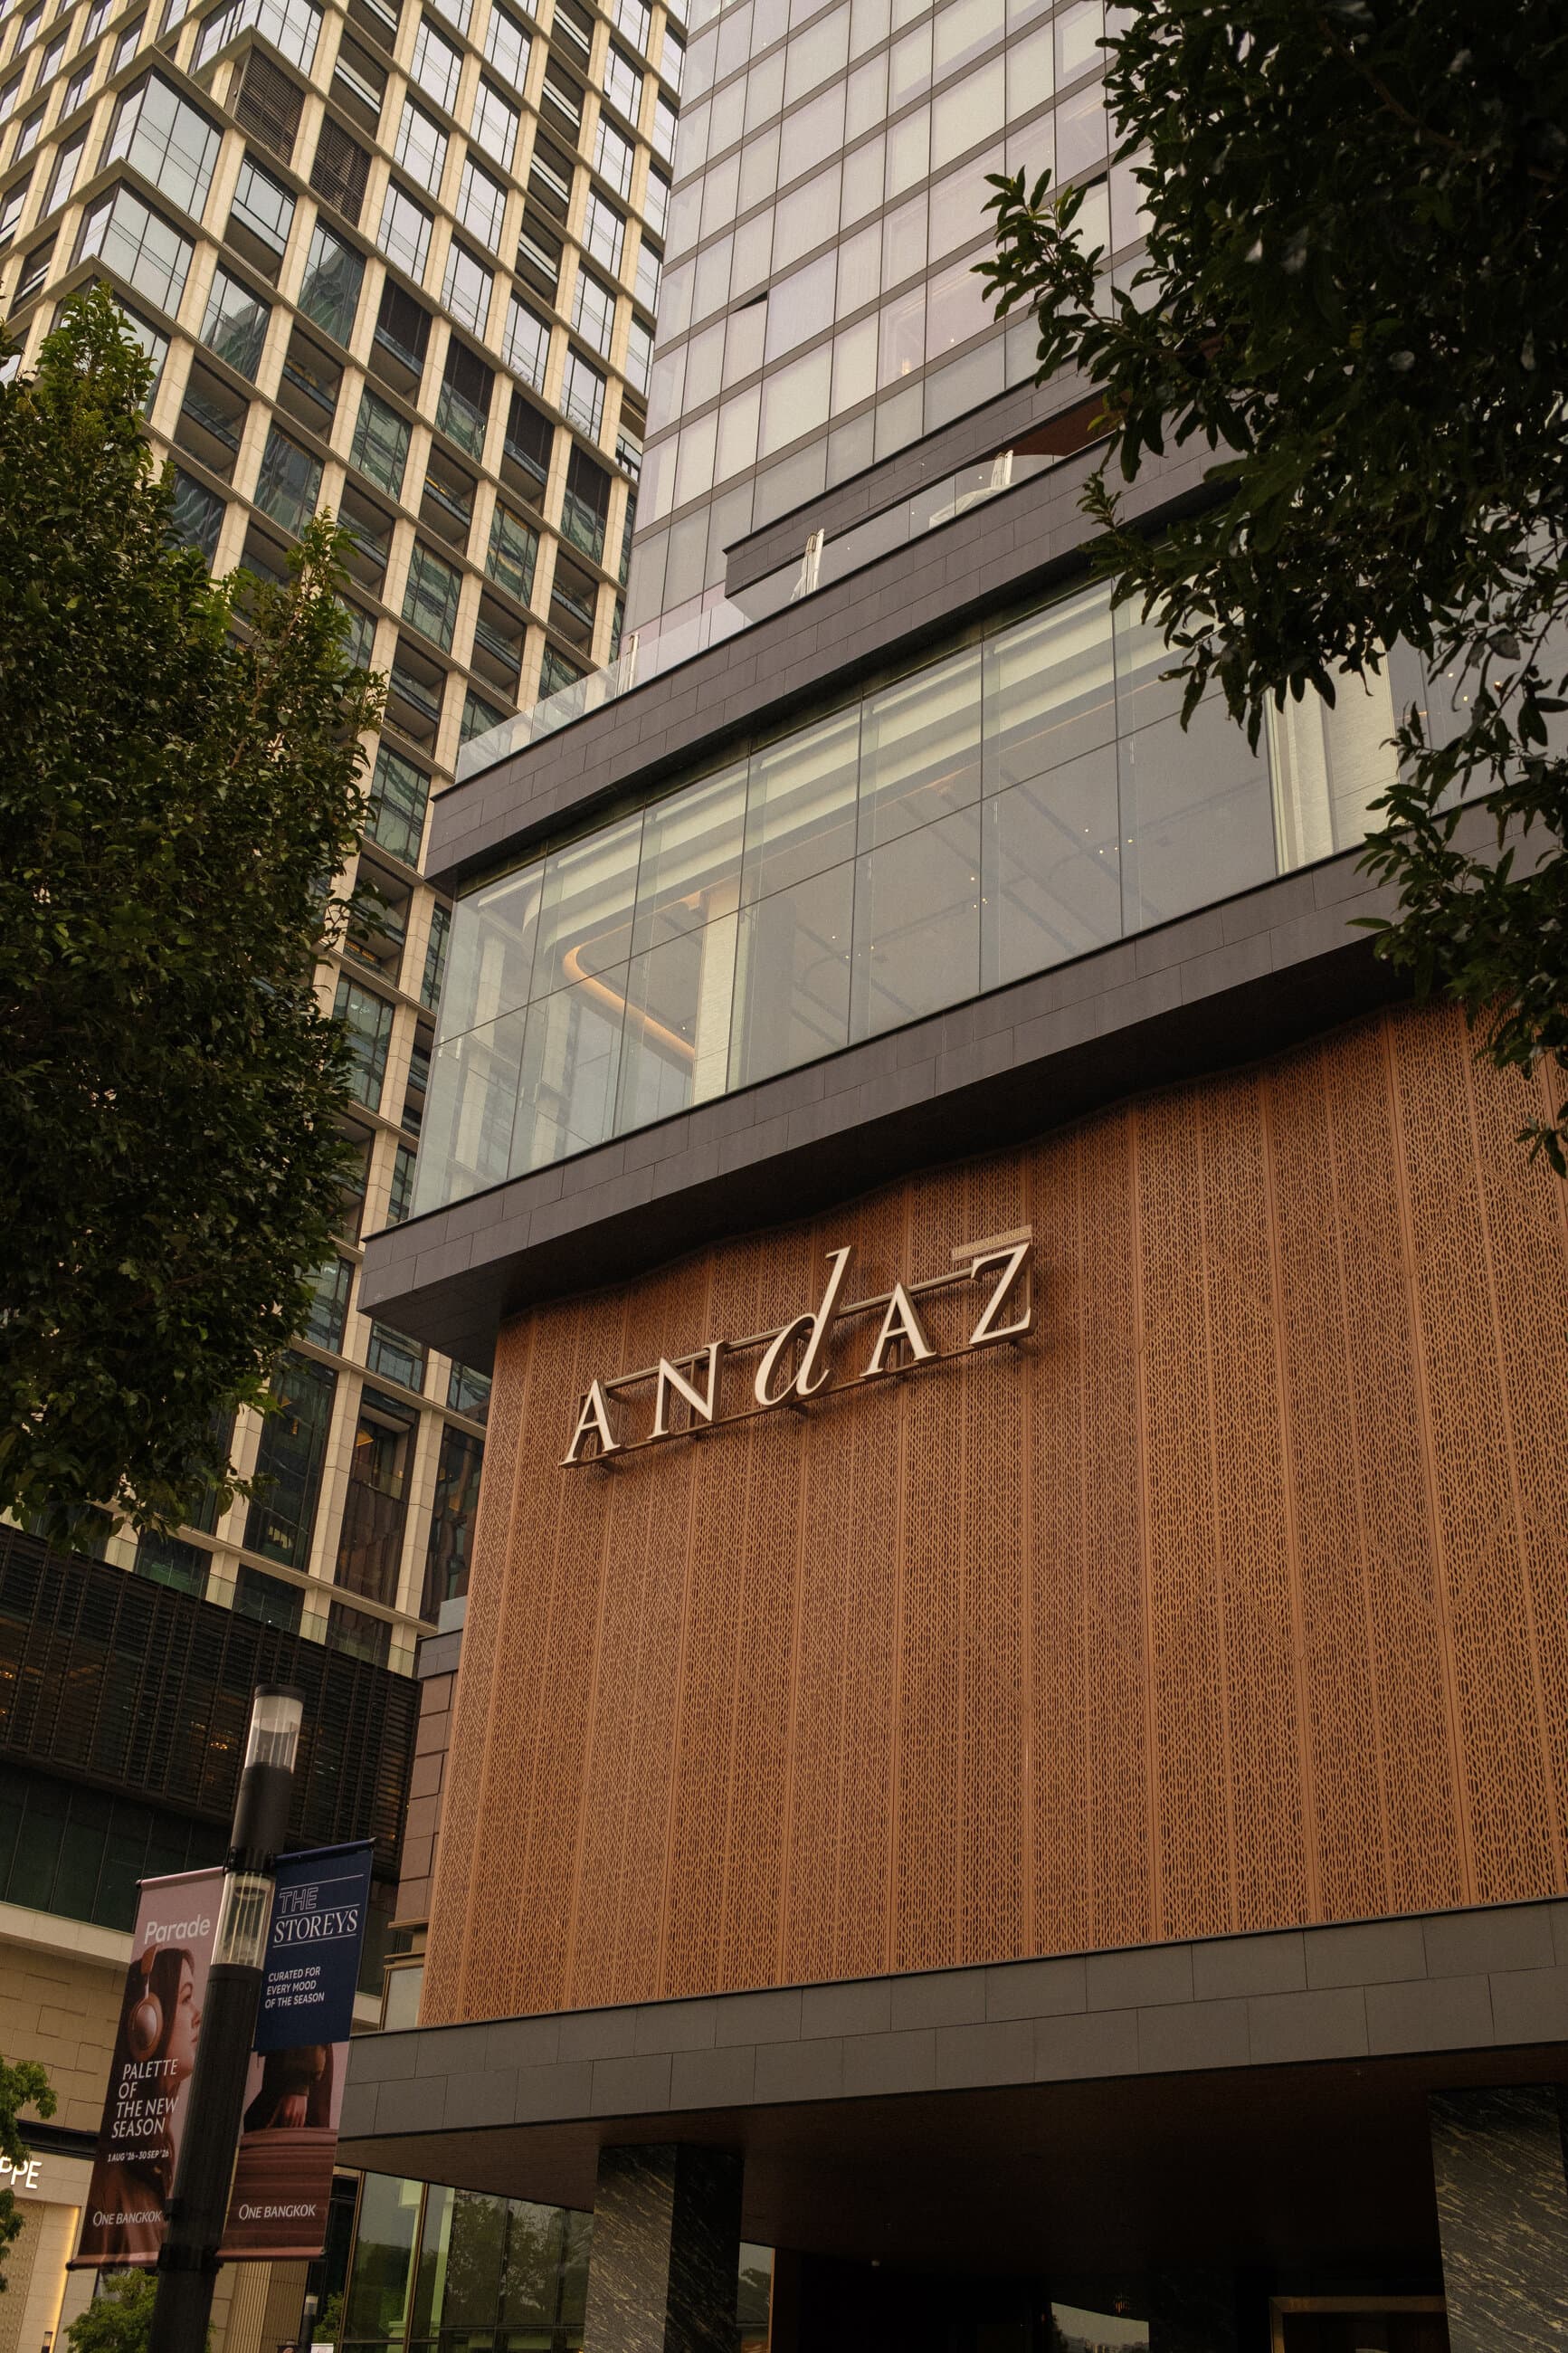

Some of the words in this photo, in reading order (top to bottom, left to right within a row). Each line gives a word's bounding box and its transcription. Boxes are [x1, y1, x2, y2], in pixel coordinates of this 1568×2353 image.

[280, 1887, 318, 1914] THE
[145, 1914, 211, 1945] Parade
[273, 1909, 358, 1943] STOREYS
[268, 1967, 303, 1982] CURATED
[305, 1966, 321, 1977] FOR
[266, 1983, 291, 1996] EVERY
[292, 1980, 317, 1992] MOOD
[264, 1997, 276, 2009] OF
[277, 1996, 292, 2006] THE
[293, 1992, 325, 2005] SEASON
[122, 2059, 179, 2081] PALETTE
[119, 2082, 138, 2100] OF
[117, 2100, 143, 2119] THE
[145, 2096, 179, 2116] NEW
[111, 2117, 166, 2139] SEASON
[92, 2211, 115, 2226] ONE
[116, 2210, 162, 2224] BANGKOK
[239, 2204, 262, 2221] ONE
[263, 2204, 317, 2218] BANGKOK
